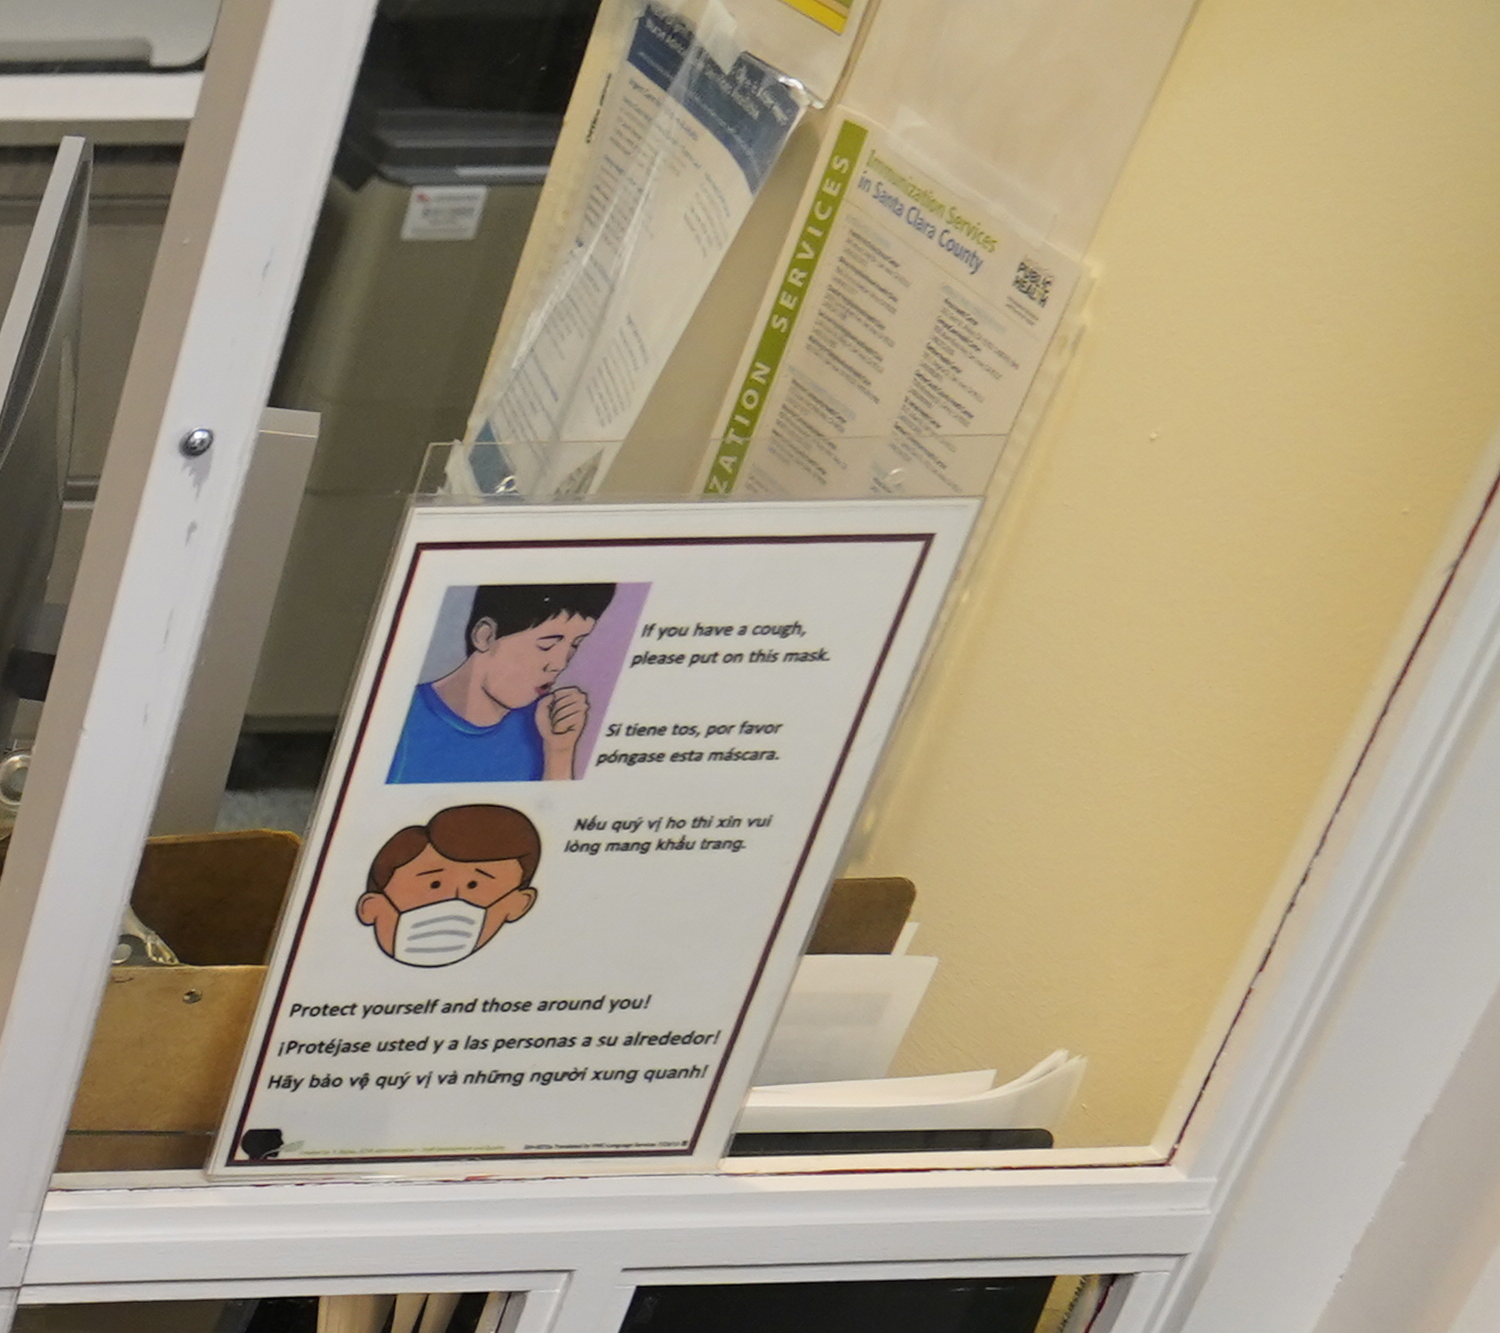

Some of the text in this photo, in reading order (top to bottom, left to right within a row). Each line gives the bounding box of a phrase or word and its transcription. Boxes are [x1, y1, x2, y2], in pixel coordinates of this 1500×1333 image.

[871, 180, 903, 217] Santa
[906, 206, 935, 239] Clara
[938, 225, 984, 275] County
[947, 206, 999, 253] Services
[772, 154, 850, 333] SERVICES
[641, 621, 806, 640] If you have a cough,
[629, 648, 830, 668] please put on this mask.
[606, 721, 784, 738] Si tiene tos, por favor
[595, 748, 780, 766] póngase esta máscara.
[612, 817, 643, 832] quý
[665, 816, 687, 829] ho
[717, 815, 742, 827] xin
[747, 814, 773, 828] vui
[605, 840, 652, 854] mang
[700, 839, 746, 853] trang.
[289, 994, 651, 1019] Protect yourself and those around you!
[278, 1029, 721, 1058] ¡Protéjase usted y a las personas a su alrededor!
[267, 1063, 709, 1093] Hãy bảo vệ quý vị và những người xung quanh!
